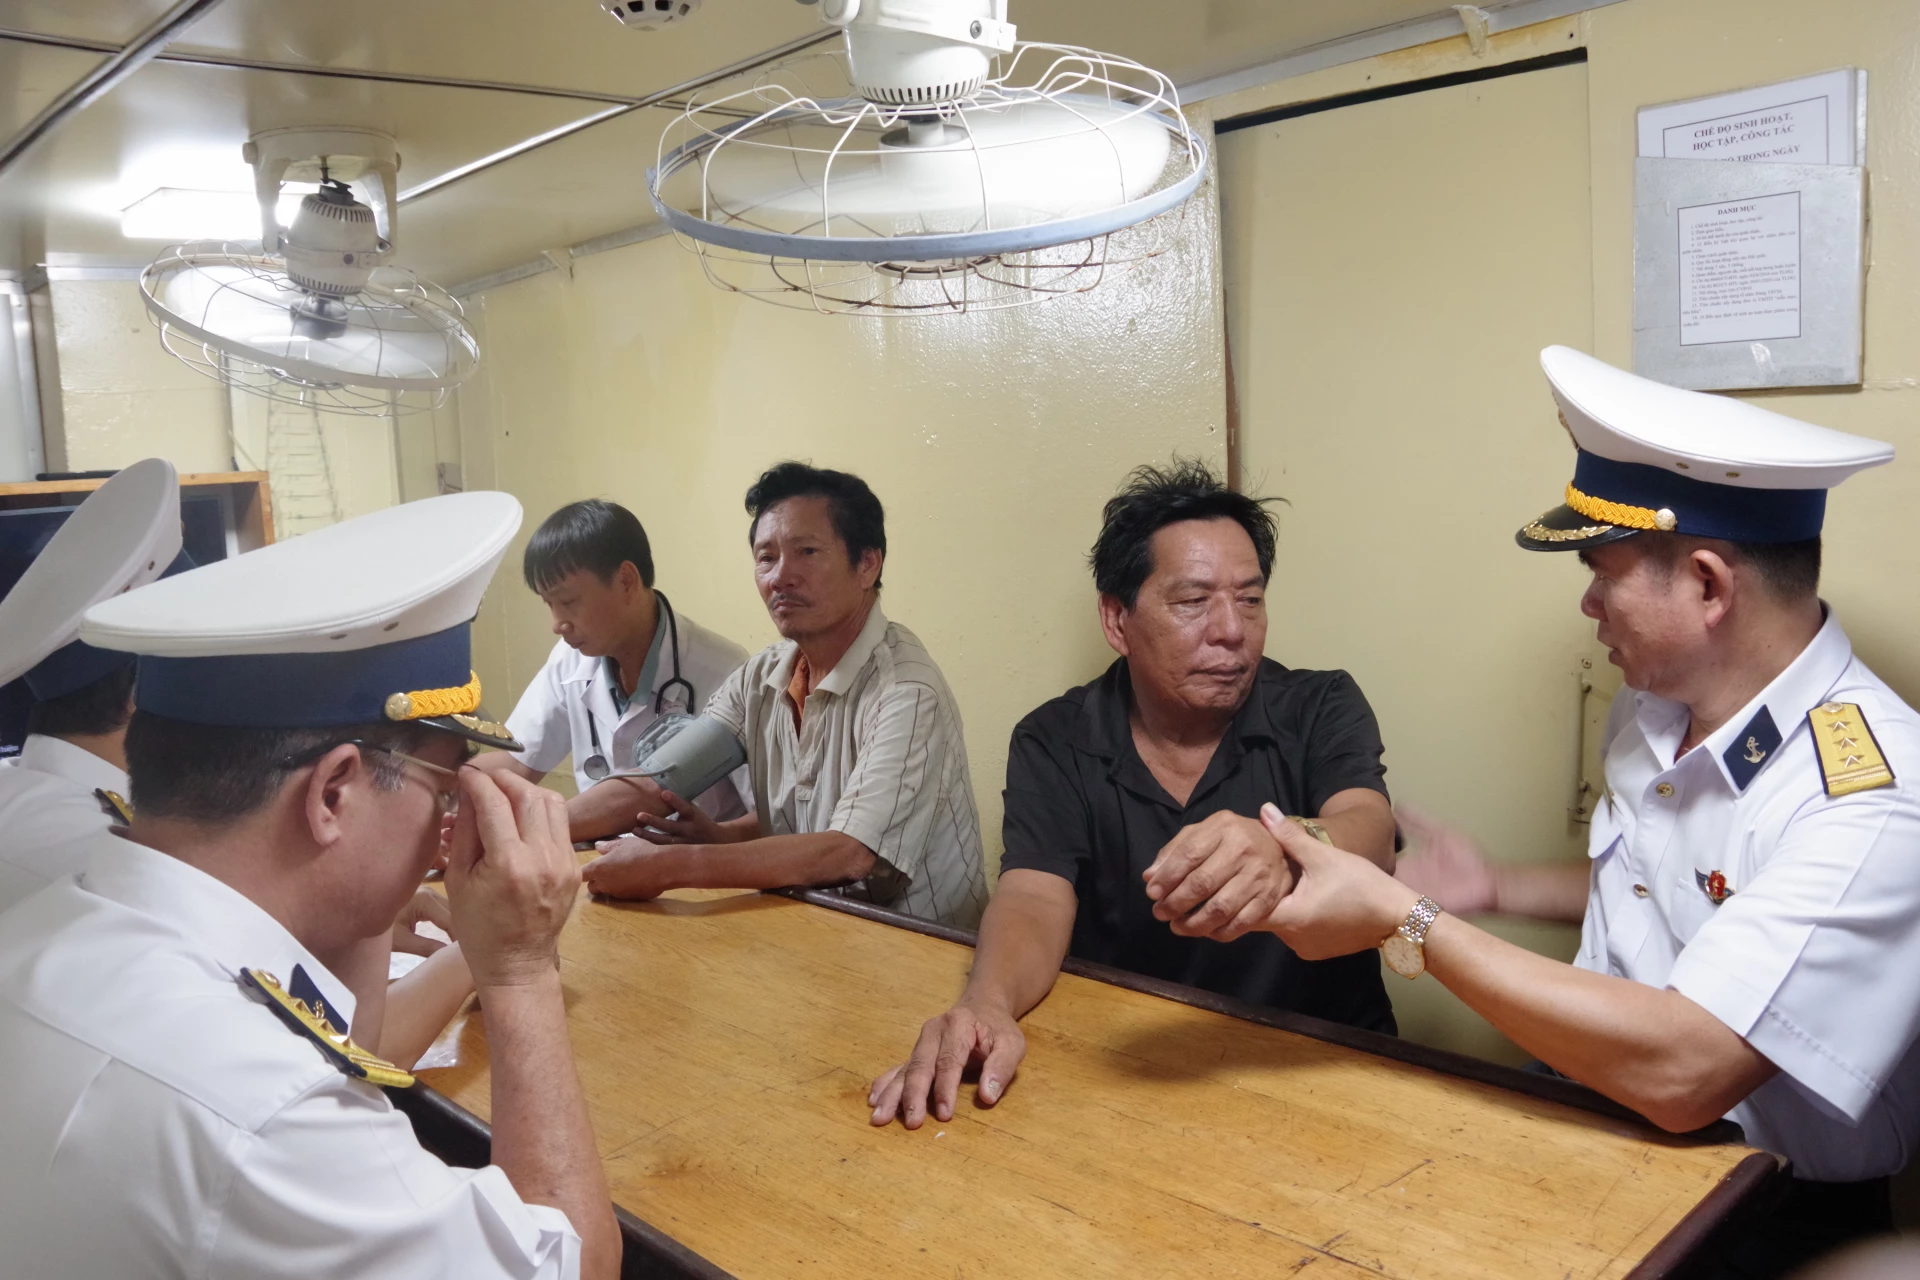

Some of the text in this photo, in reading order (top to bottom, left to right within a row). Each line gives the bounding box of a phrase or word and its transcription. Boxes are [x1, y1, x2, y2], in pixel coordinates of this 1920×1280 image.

[1734, 119, 1758, 130] SINH
[1693, 140, 1715, 151] HỌC
[1737, 151, 1770, 161] TRONG
[1718, 207, 1738, 215] DANH
